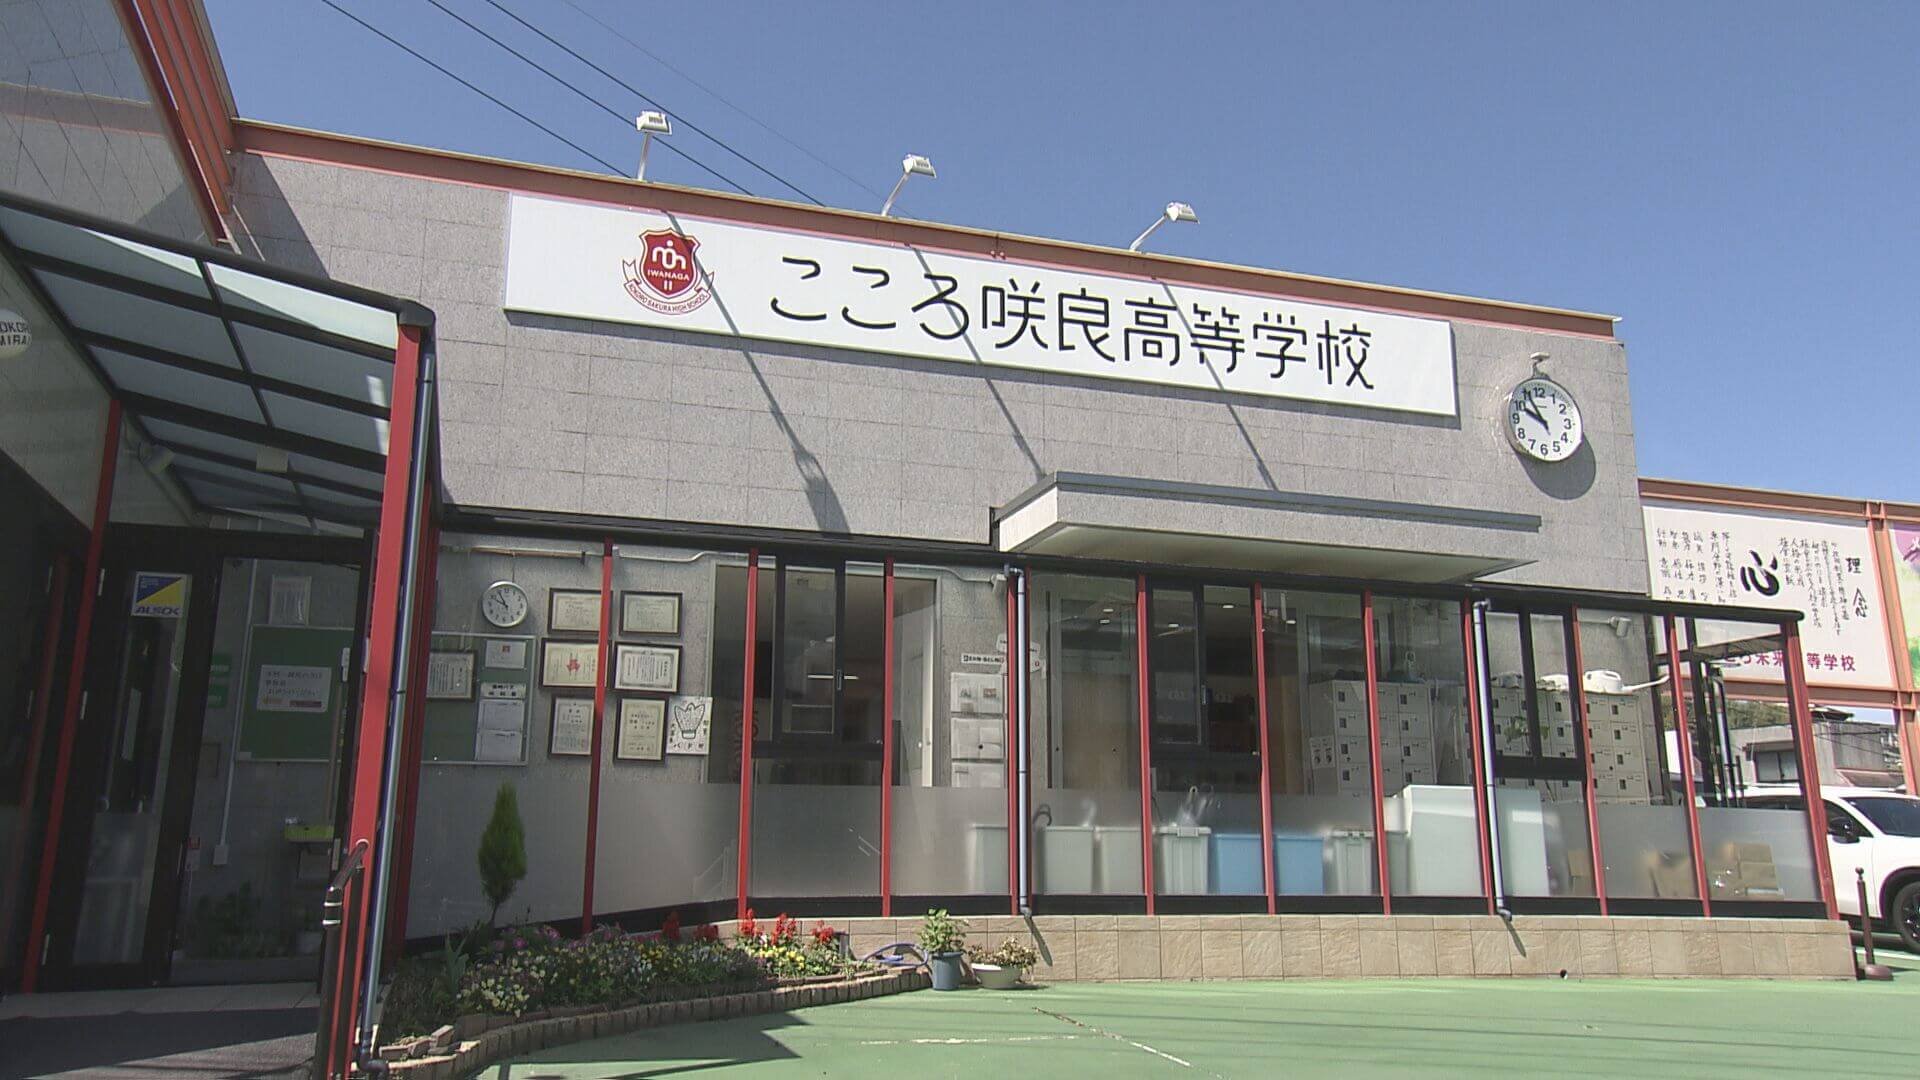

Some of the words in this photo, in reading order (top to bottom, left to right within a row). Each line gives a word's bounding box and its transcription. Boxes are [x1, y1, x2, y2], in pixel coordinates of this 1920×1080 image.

[647, 269, 690, 281] IWANAGA
[770, 255, 1375, 390] こころ咲良高等学校
[1533, 387, 1546, 399] 12
[1514, 400, 1526, 412] 10
[1559, 403, 1566, 415] 2
[1512, 412, 1520, 425] 9
[1563, 418, 1572, 430] 3
[1517, 427, 1526, 440] 8
[1560, 432, 1568, 444] 4
[1527, 438, 1536, 450] 7
[1540, 444, 1549, 456] 6
[1552, 441, 1560, 453] 5
[1740, 550, 1780, 597] 心
[1845, 557, 1867, 618] 理念
